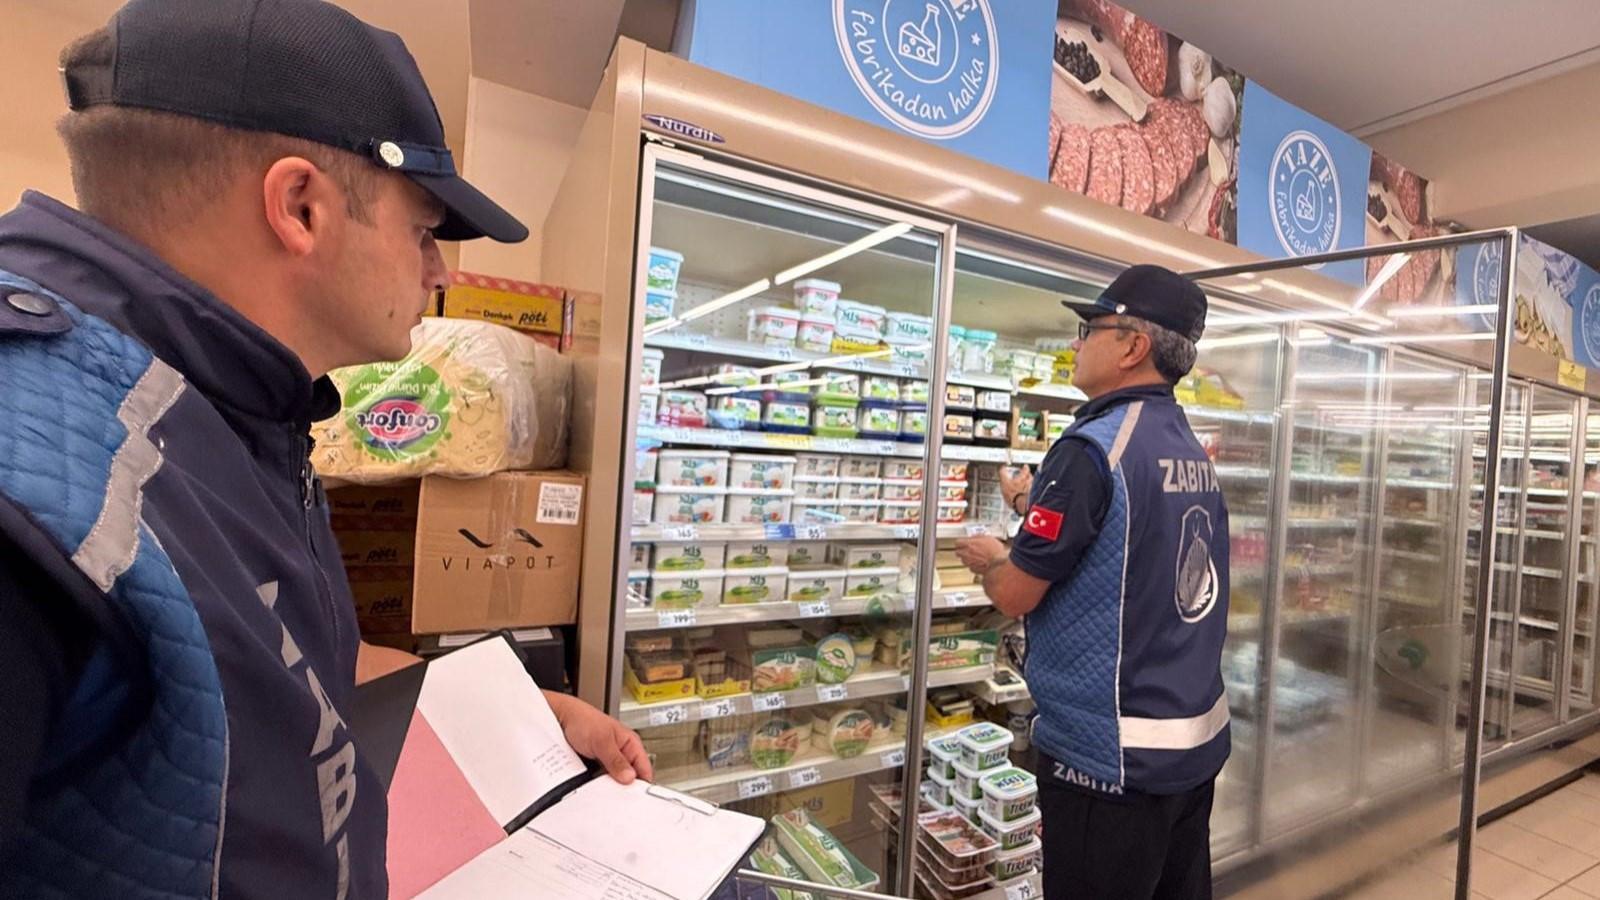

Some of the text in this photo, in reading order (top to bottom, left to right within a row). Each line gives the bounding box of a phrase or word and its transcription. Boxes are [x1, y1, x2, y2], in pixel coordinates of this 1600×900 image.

[851, 10, 985, 120] fabrikadan halka
[1282, 141, 1332, 189] TAZE
[356, 410, 440, 432] Confort
[1158, 459, 1220, 493] ZABITA
[442, 556, 555, 571] VIAPOT
[666, 710, 680, 722] 92
[717, 704, 729, 715] 75
